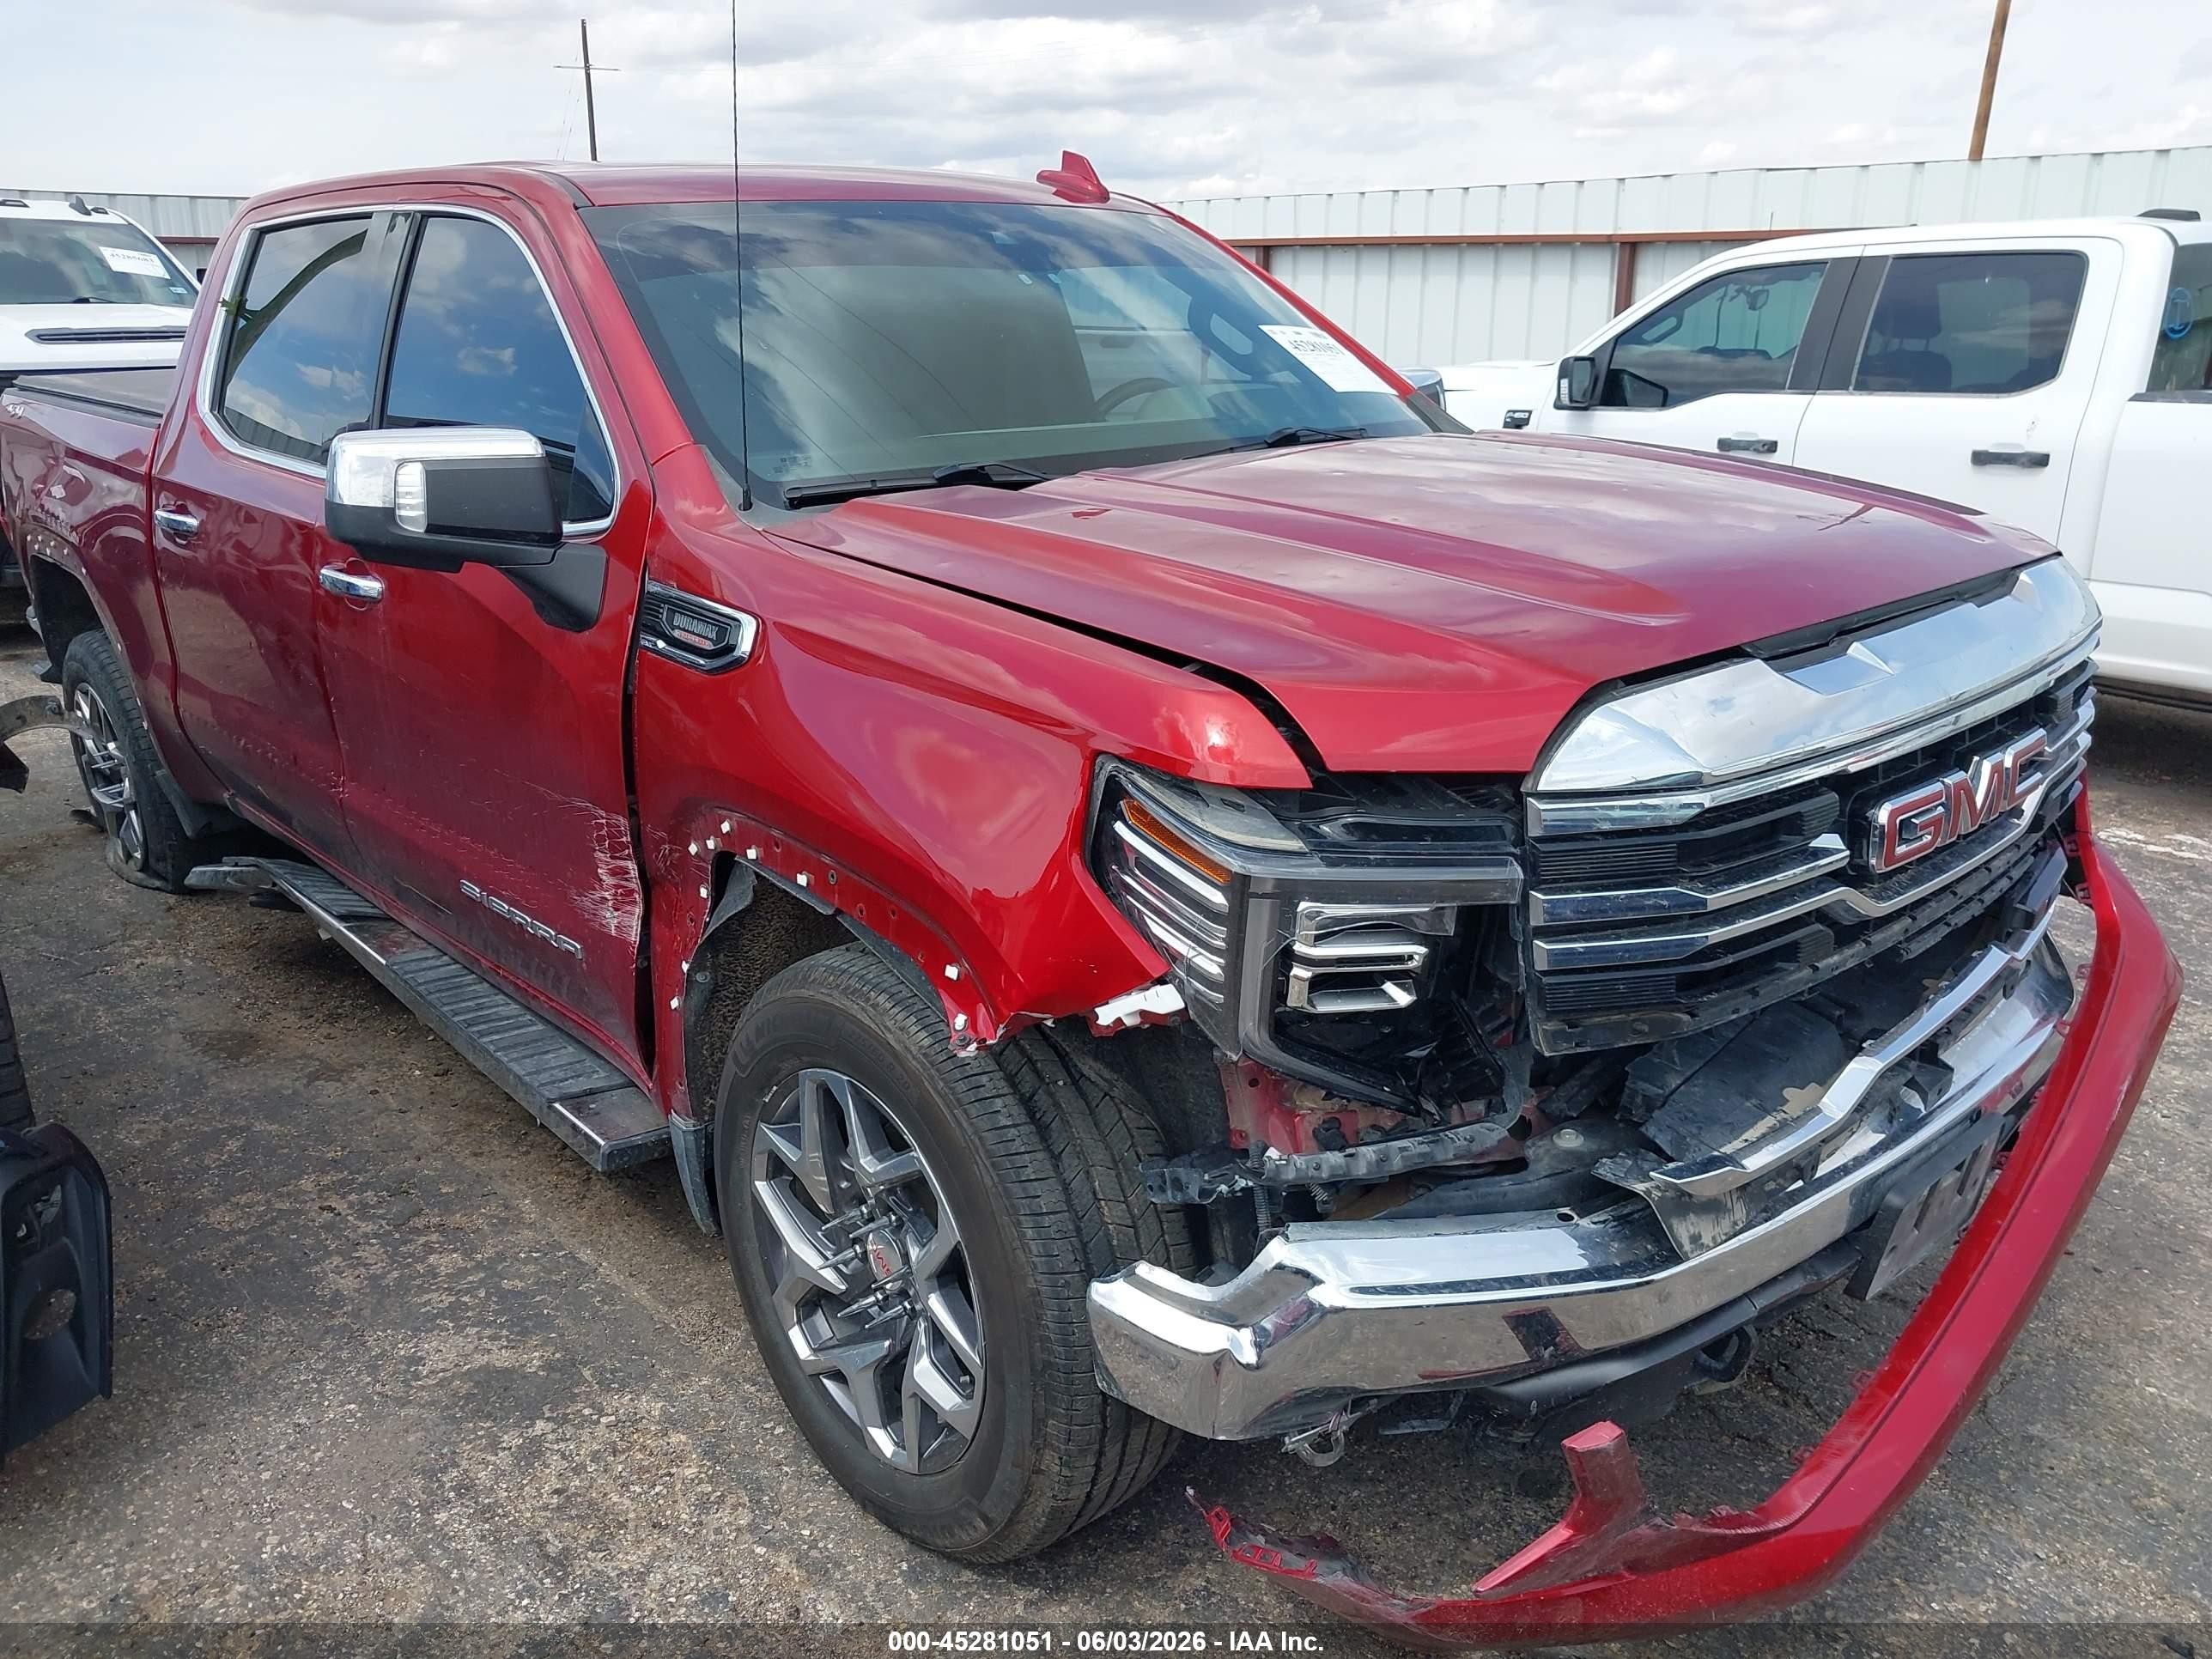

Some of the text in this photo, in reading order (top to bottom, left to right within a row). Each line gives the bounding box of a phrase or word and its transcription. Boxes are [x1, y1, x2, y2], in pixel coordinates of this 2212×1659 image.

[672, 612, 720, 641] DURAMAX
[1869, 727, 2049, 874] GMC
[459, 878, 584, 960] SIERRA
